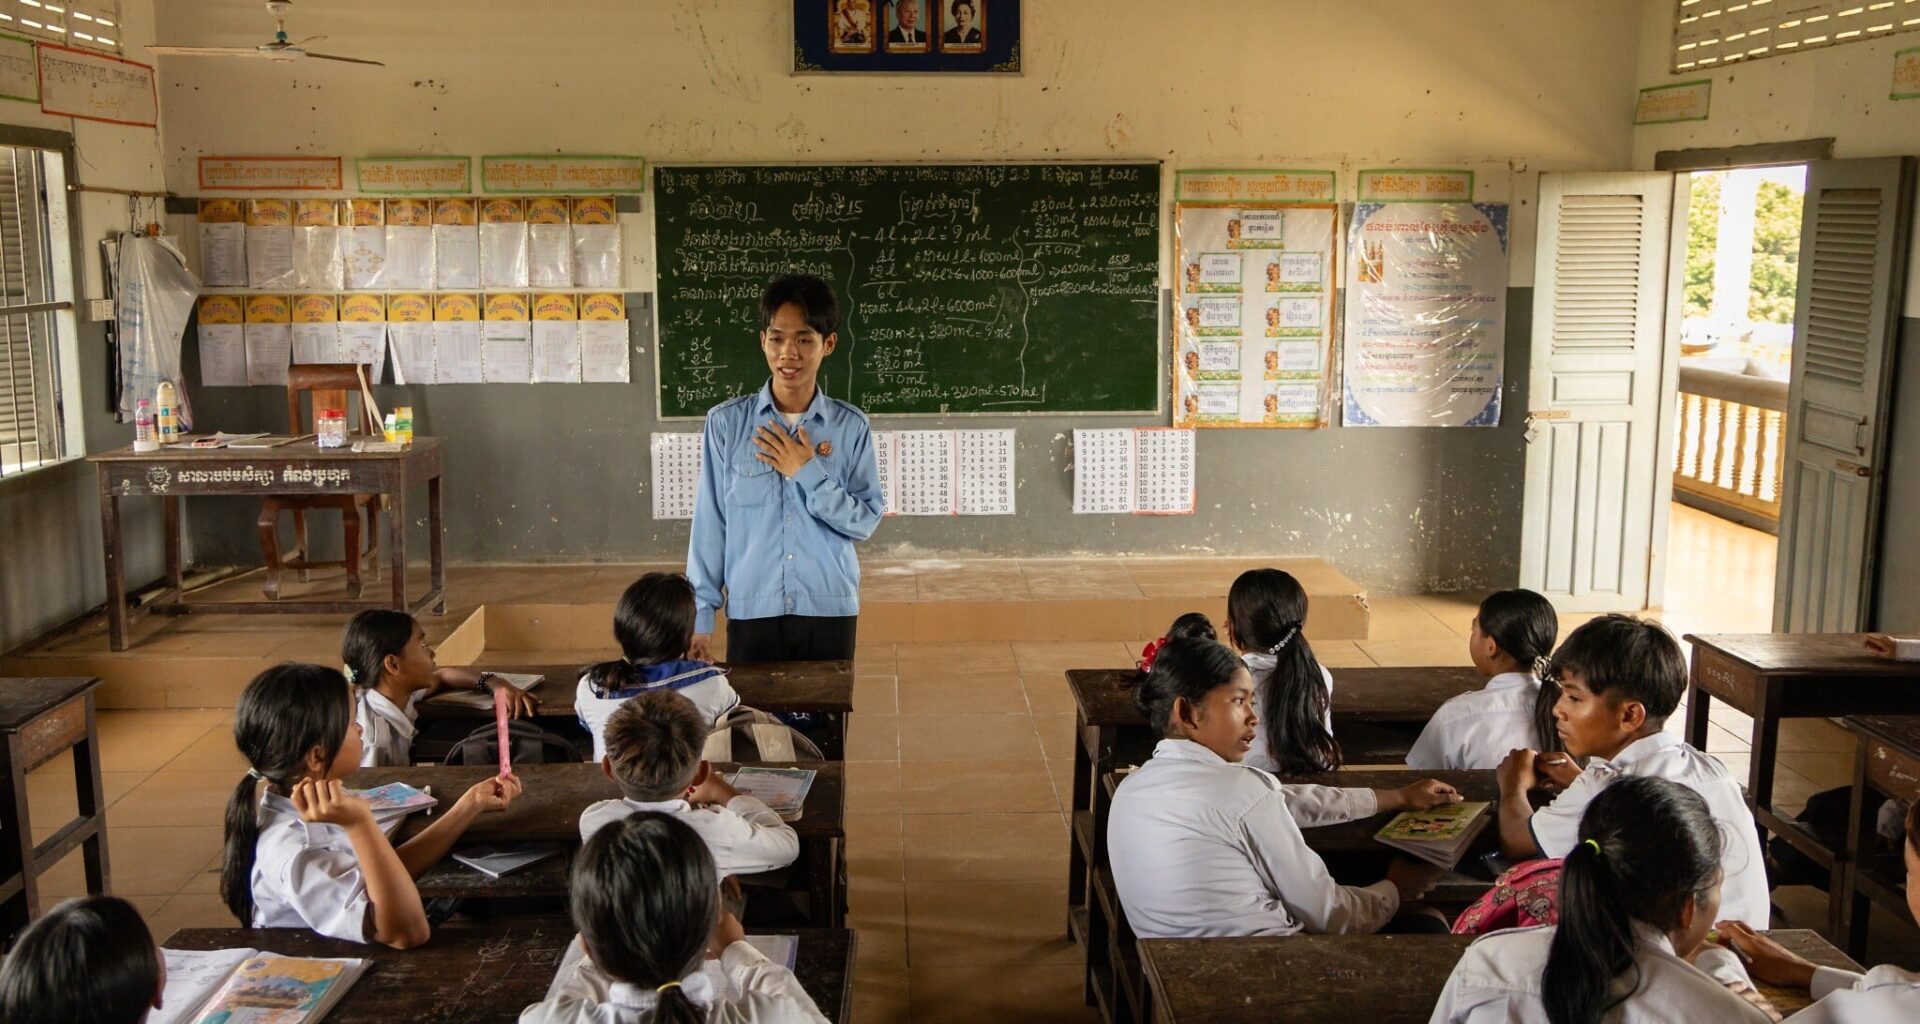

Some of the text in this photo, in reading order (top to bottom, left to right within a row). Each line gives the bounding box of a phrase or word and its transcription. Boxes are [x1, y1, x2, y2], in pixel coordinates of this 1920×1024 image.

[847, 200, 863, 215] 15
[877, 284, 899, 299] 6l
[947, 295, 996, 312] 6000ml
[730, 308, 753, 323] 2l
